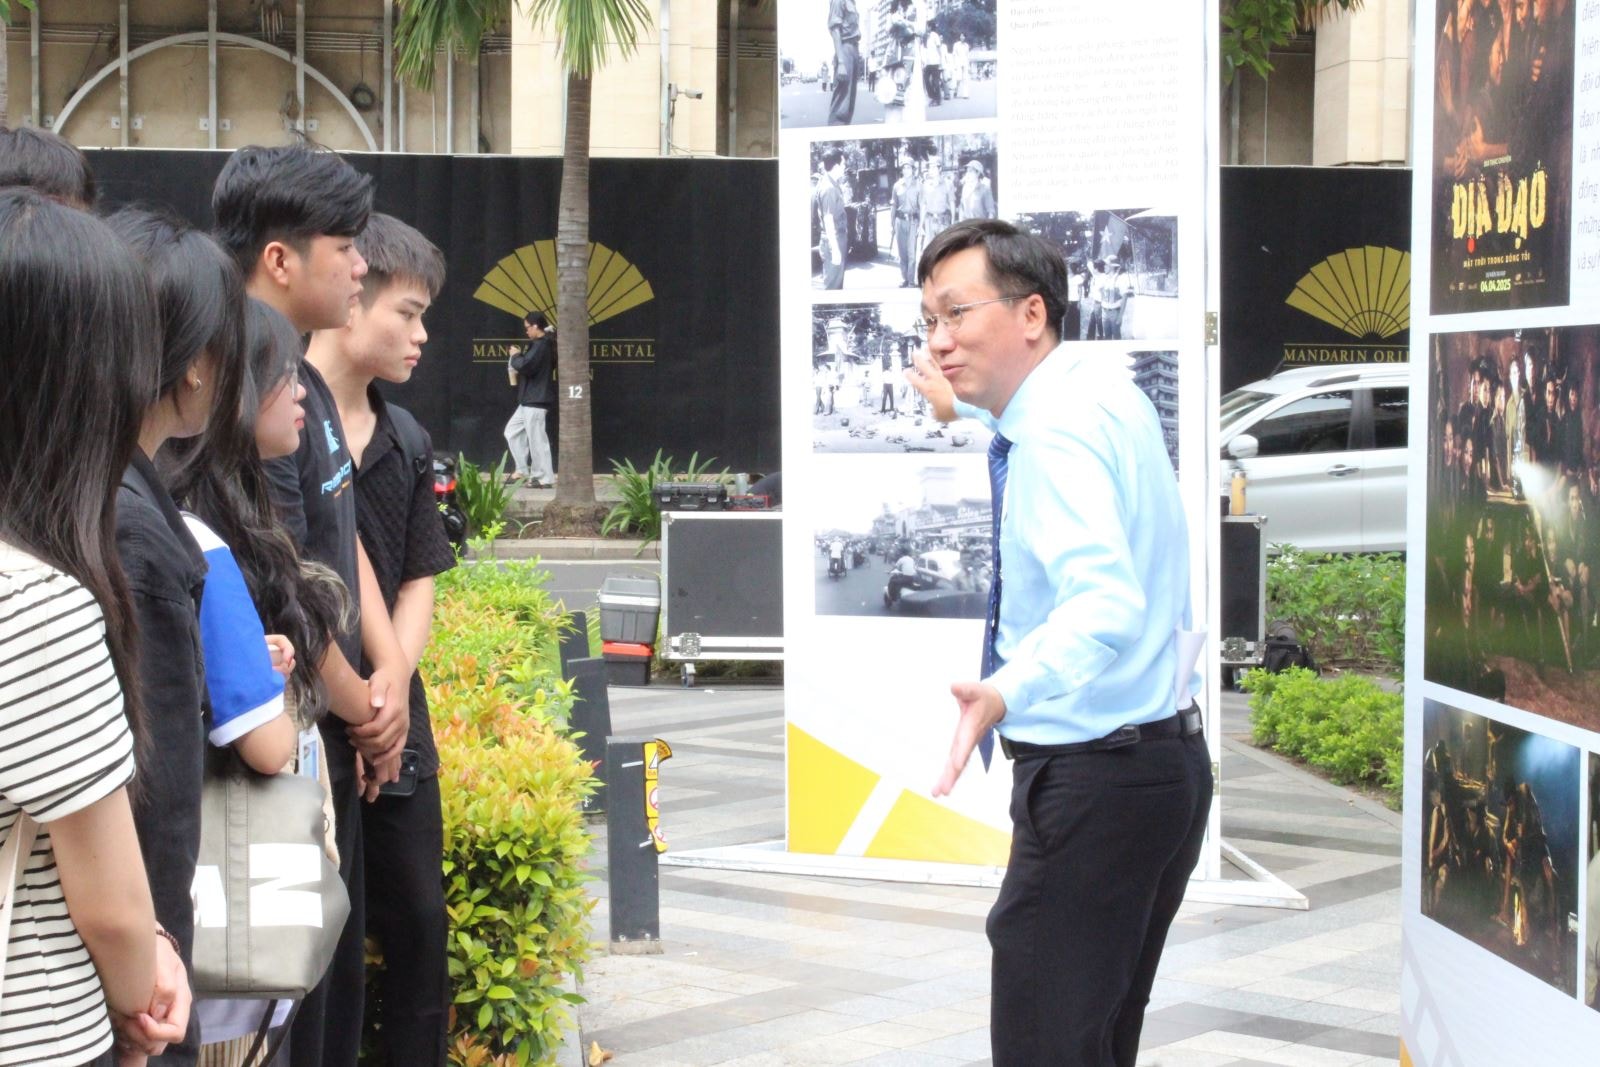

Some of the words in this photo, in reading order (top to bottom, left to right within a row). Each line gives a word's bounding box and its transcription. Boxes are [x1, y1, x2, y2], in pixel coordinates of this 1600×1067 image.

[1480, 279, 1511, 292] 04.04.2025
[593, 344, 655, 358] IENTAL
[1283, 348, 1367, 362] MANDARIN
[568, 385, 583, 399] 12
